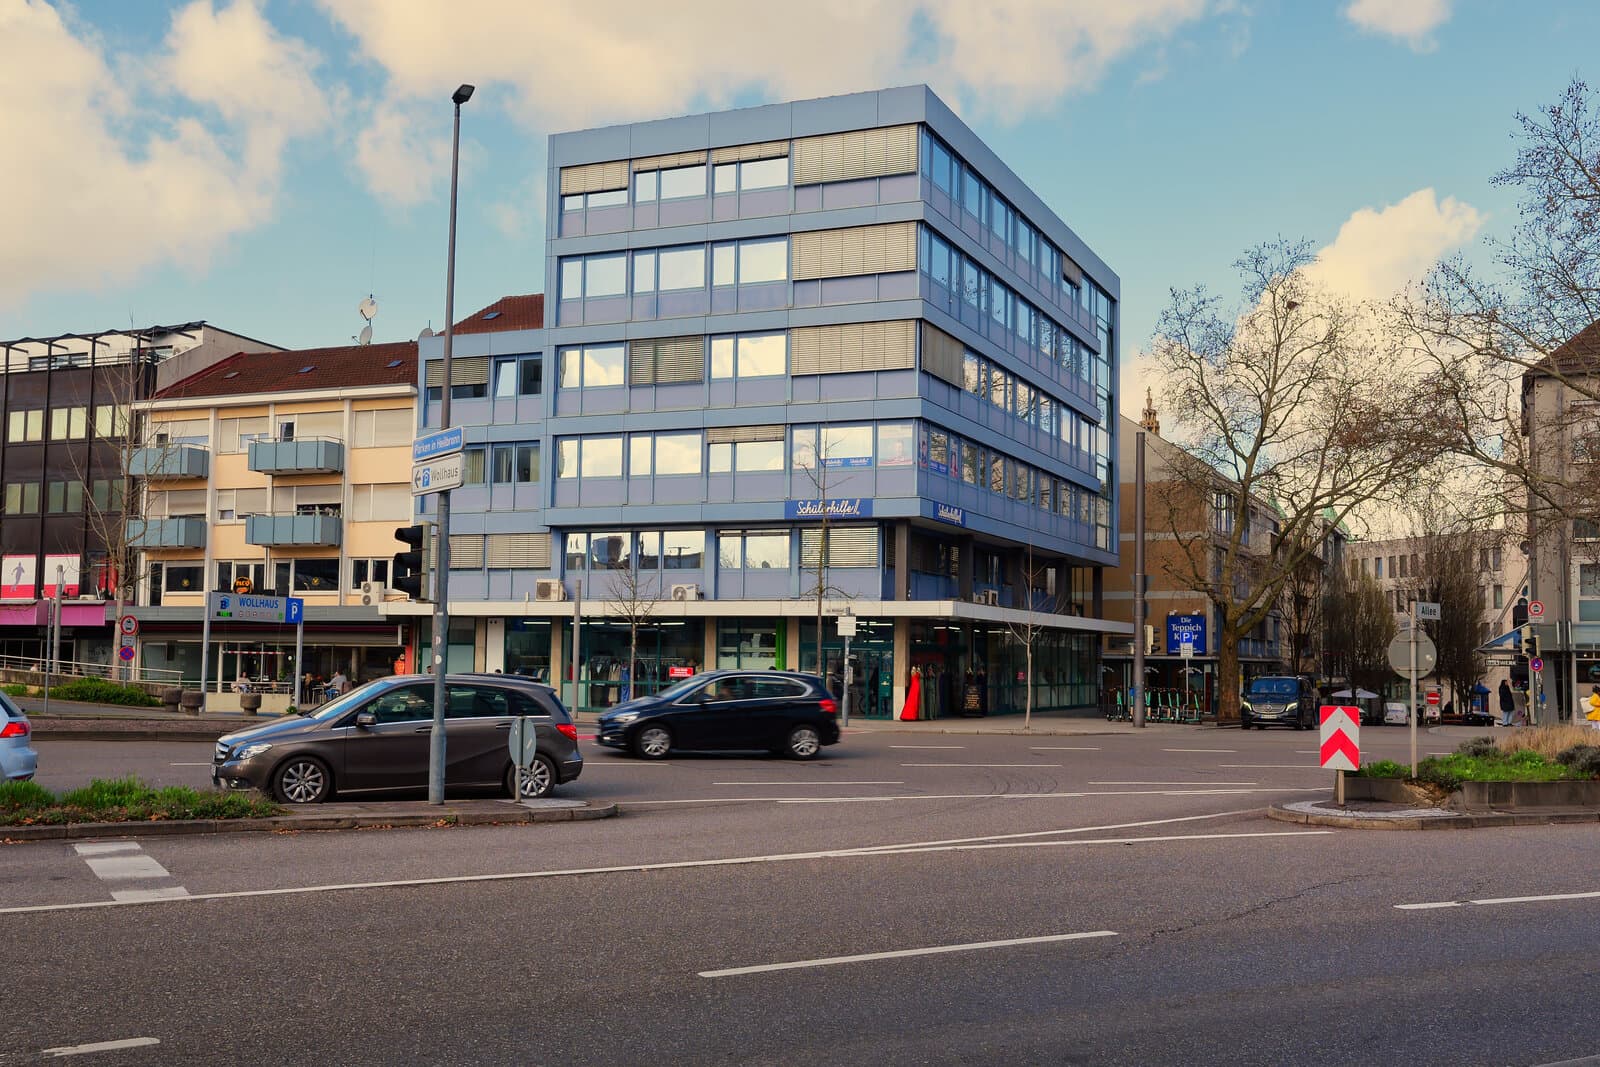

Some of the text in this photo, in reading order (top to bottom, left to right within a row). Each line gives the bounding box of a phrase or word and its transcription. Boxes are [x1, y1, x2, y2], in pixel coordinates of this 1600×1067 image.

[415, 441, 430, 455] Parken
[436, 434, 460, 449] Heilbronn
[431, 467, 458, 481] Wollhaus
[239, 597, 279, 609] WOLLHAUS
[1421, 605, 1437, 616] Allee
[1171, 623, 1202, 632] Teppich
